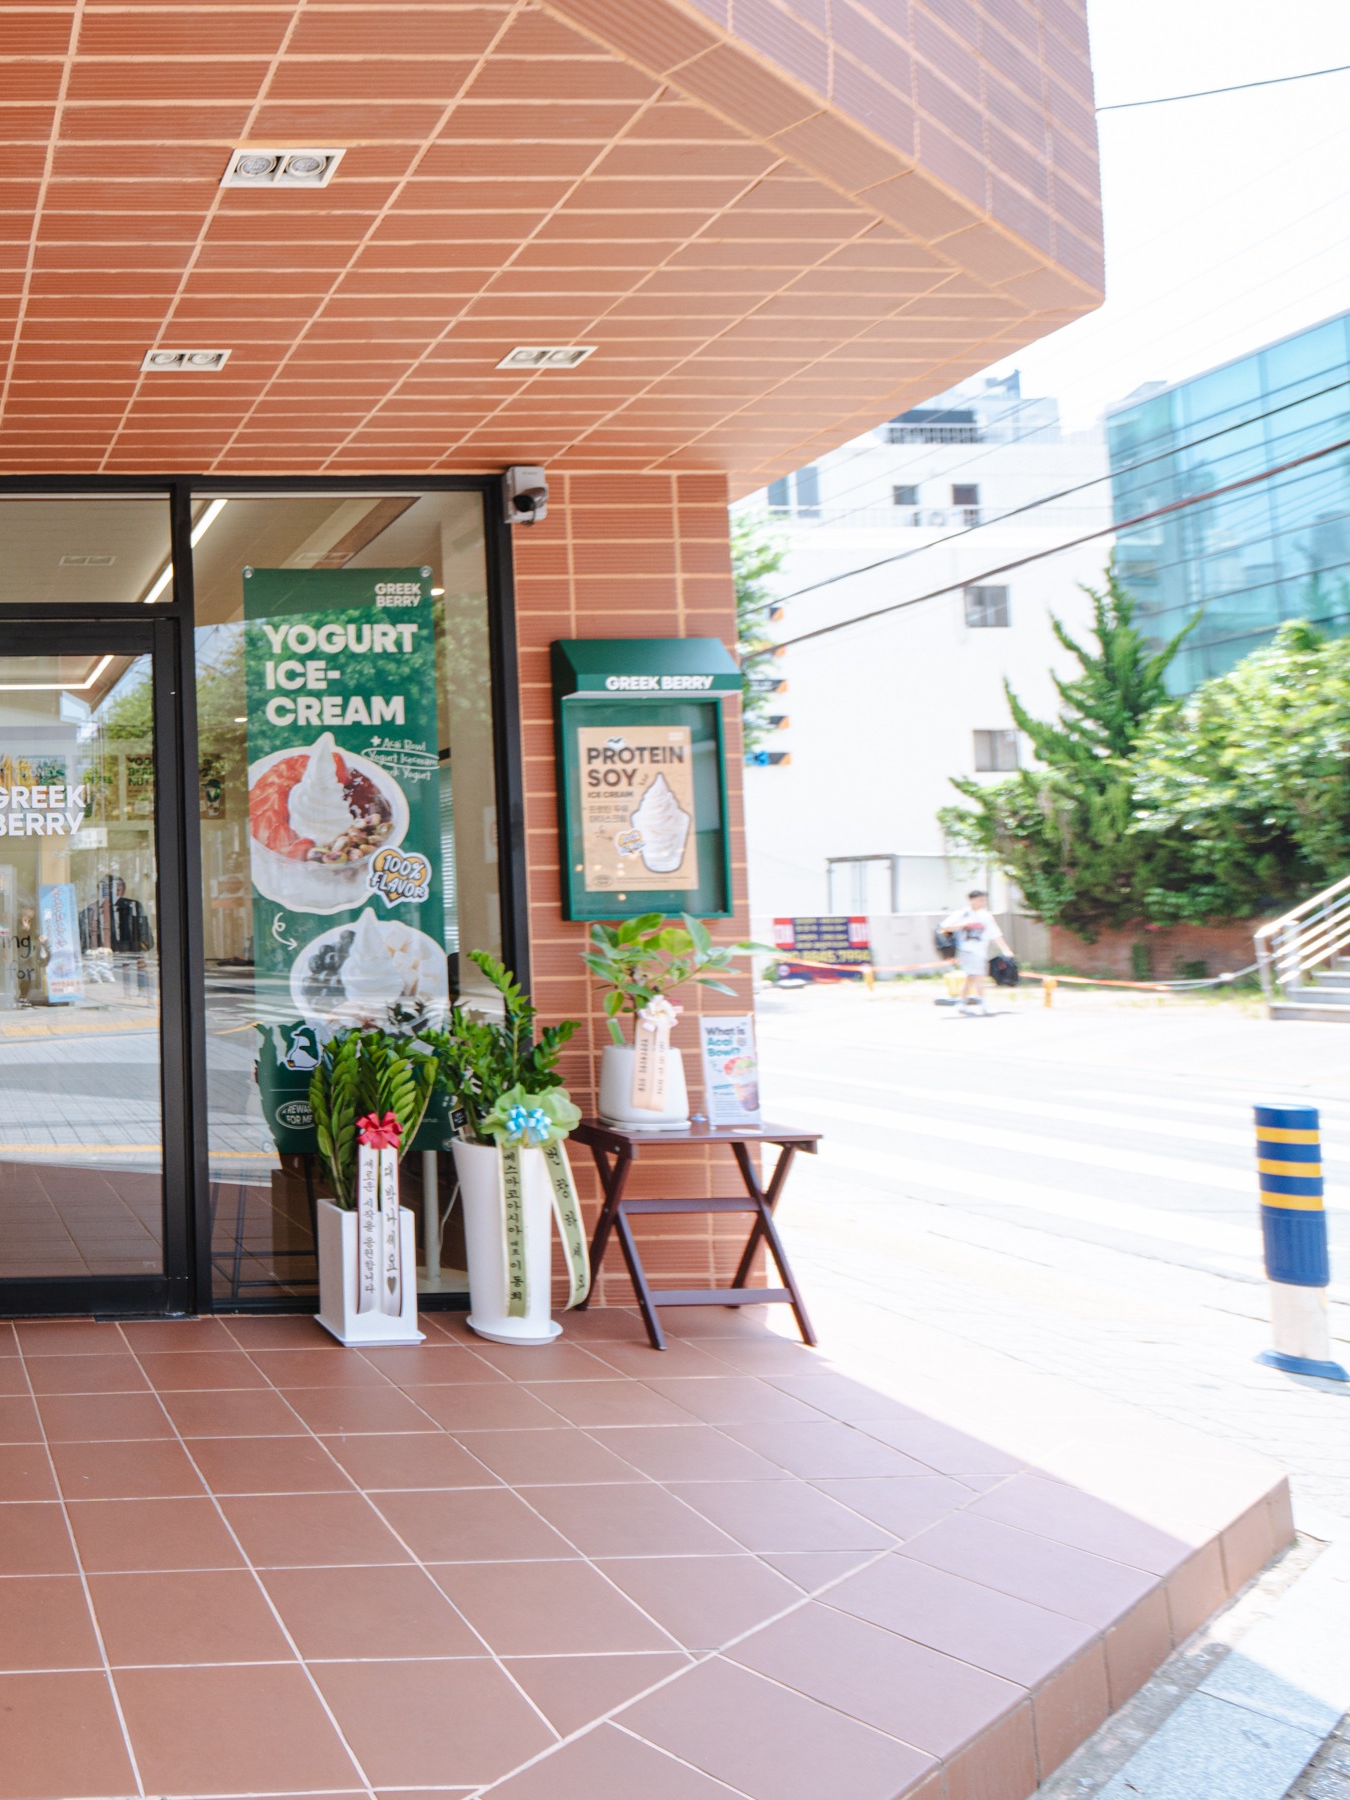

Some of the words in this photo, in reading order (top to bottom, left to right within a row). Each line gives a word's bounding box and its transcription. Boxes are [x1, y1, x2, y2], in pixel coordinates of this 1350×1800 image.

[374, 582, 422, 596] GREEK
[375, 595, 421, 607] BERRY
[262, 623, 418, 654] YOGURT
[265, 659, 341, 690] ICE-
[605, 675, 660, 690] GREEK
[660, 675, 714, 690] BERRY
[265, 696, 406, 726] CREAM
[368, 750, 398, 765] Yogurt
[587, 746, 685, 764] PROTEIN
[402, 767, 431, 783] Yogurt
[588, 768, 638, 787] SOY
[383, 854, 426, 880] 100%
[370, 871, 426, 898] FLAVOR
[286, 1115, 302, 1124] FOR
